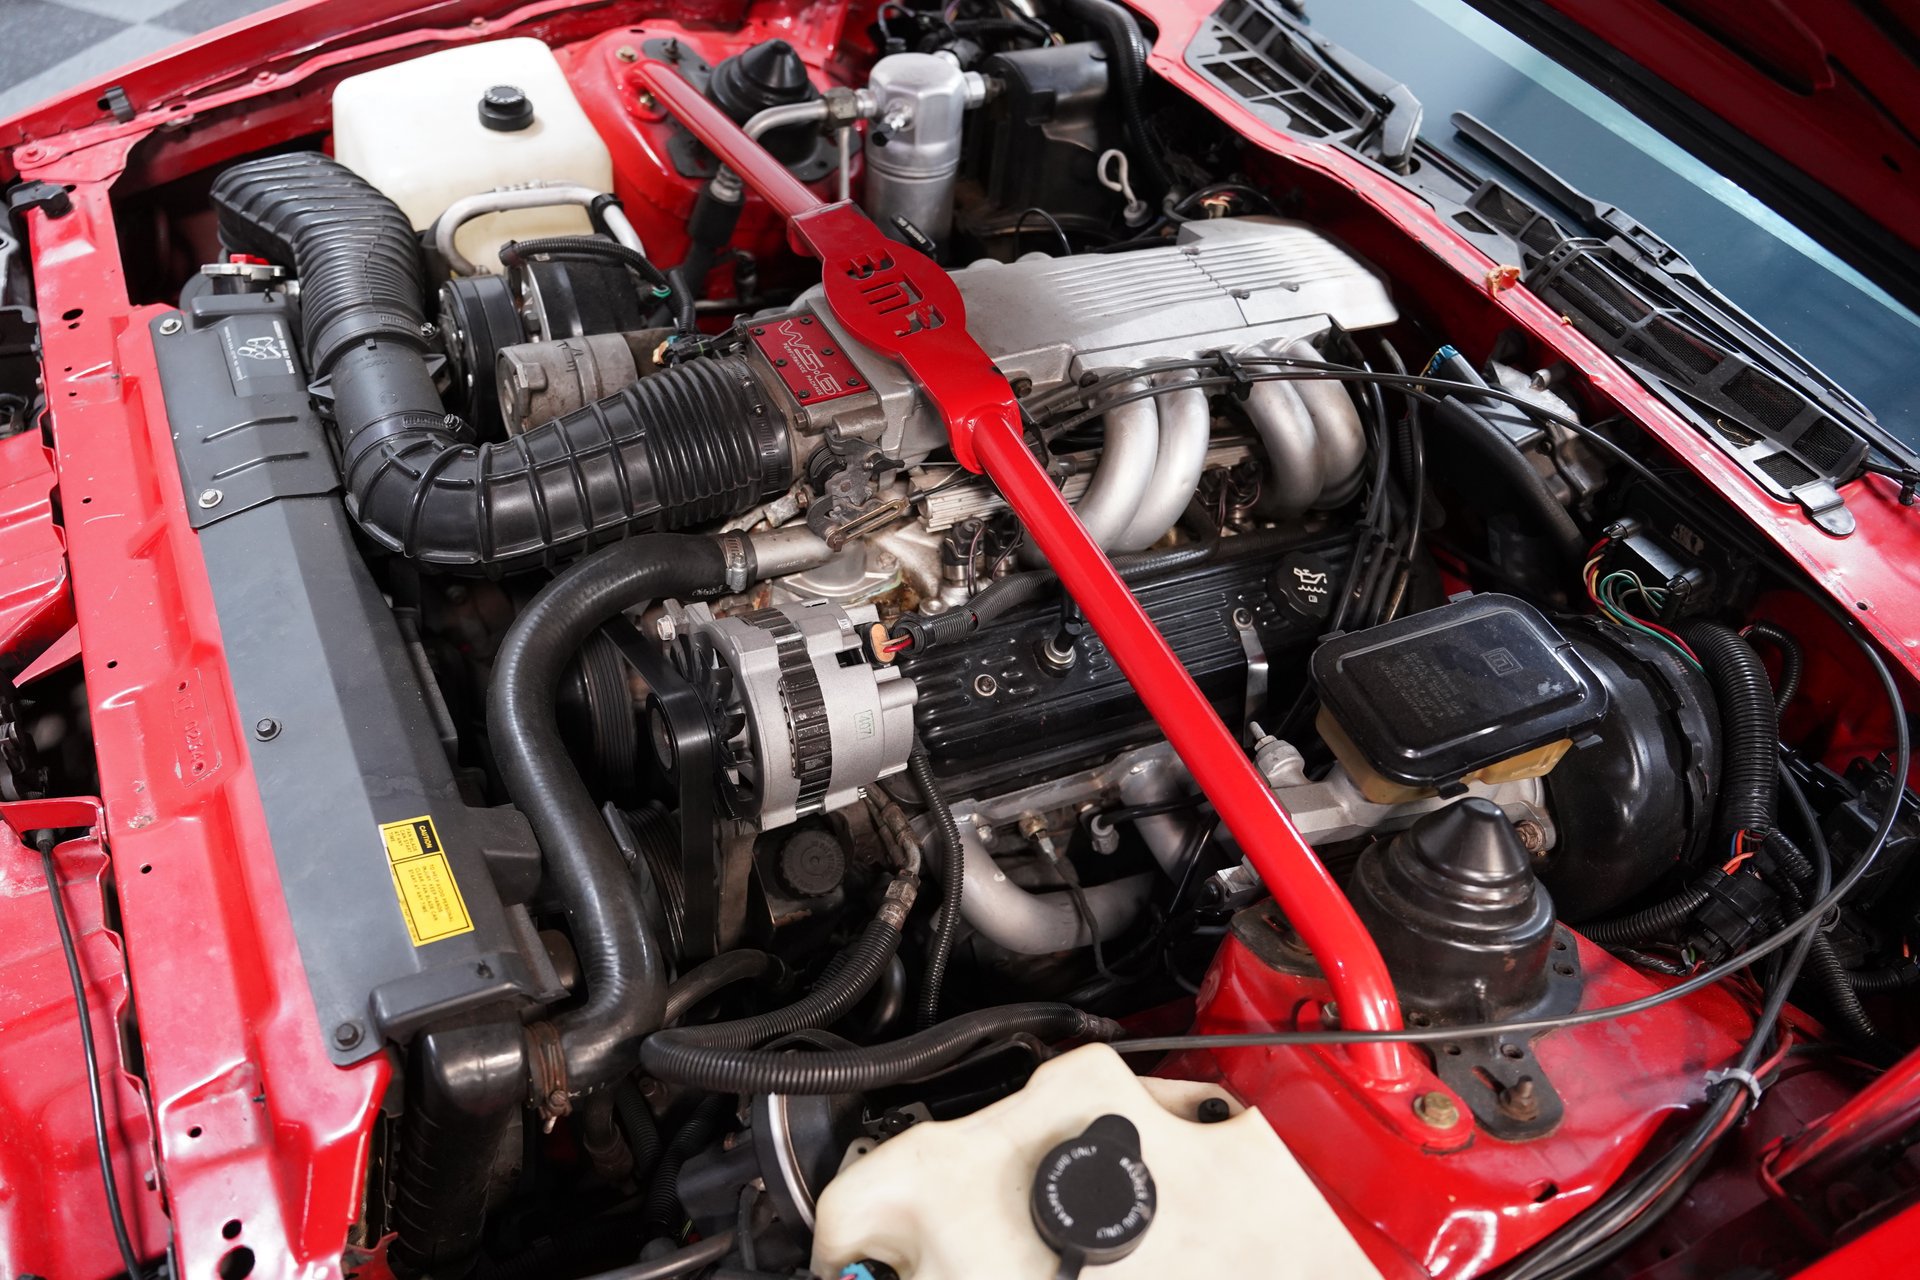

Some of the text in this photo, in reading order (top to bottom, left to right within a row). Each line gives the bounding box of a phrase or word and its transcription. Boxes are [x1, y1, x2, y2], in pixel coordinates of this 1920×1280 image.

[782, 342, 825, 397] PERFORMANCE PACKAGE
[419, 825, 433, 849] CAUTION
